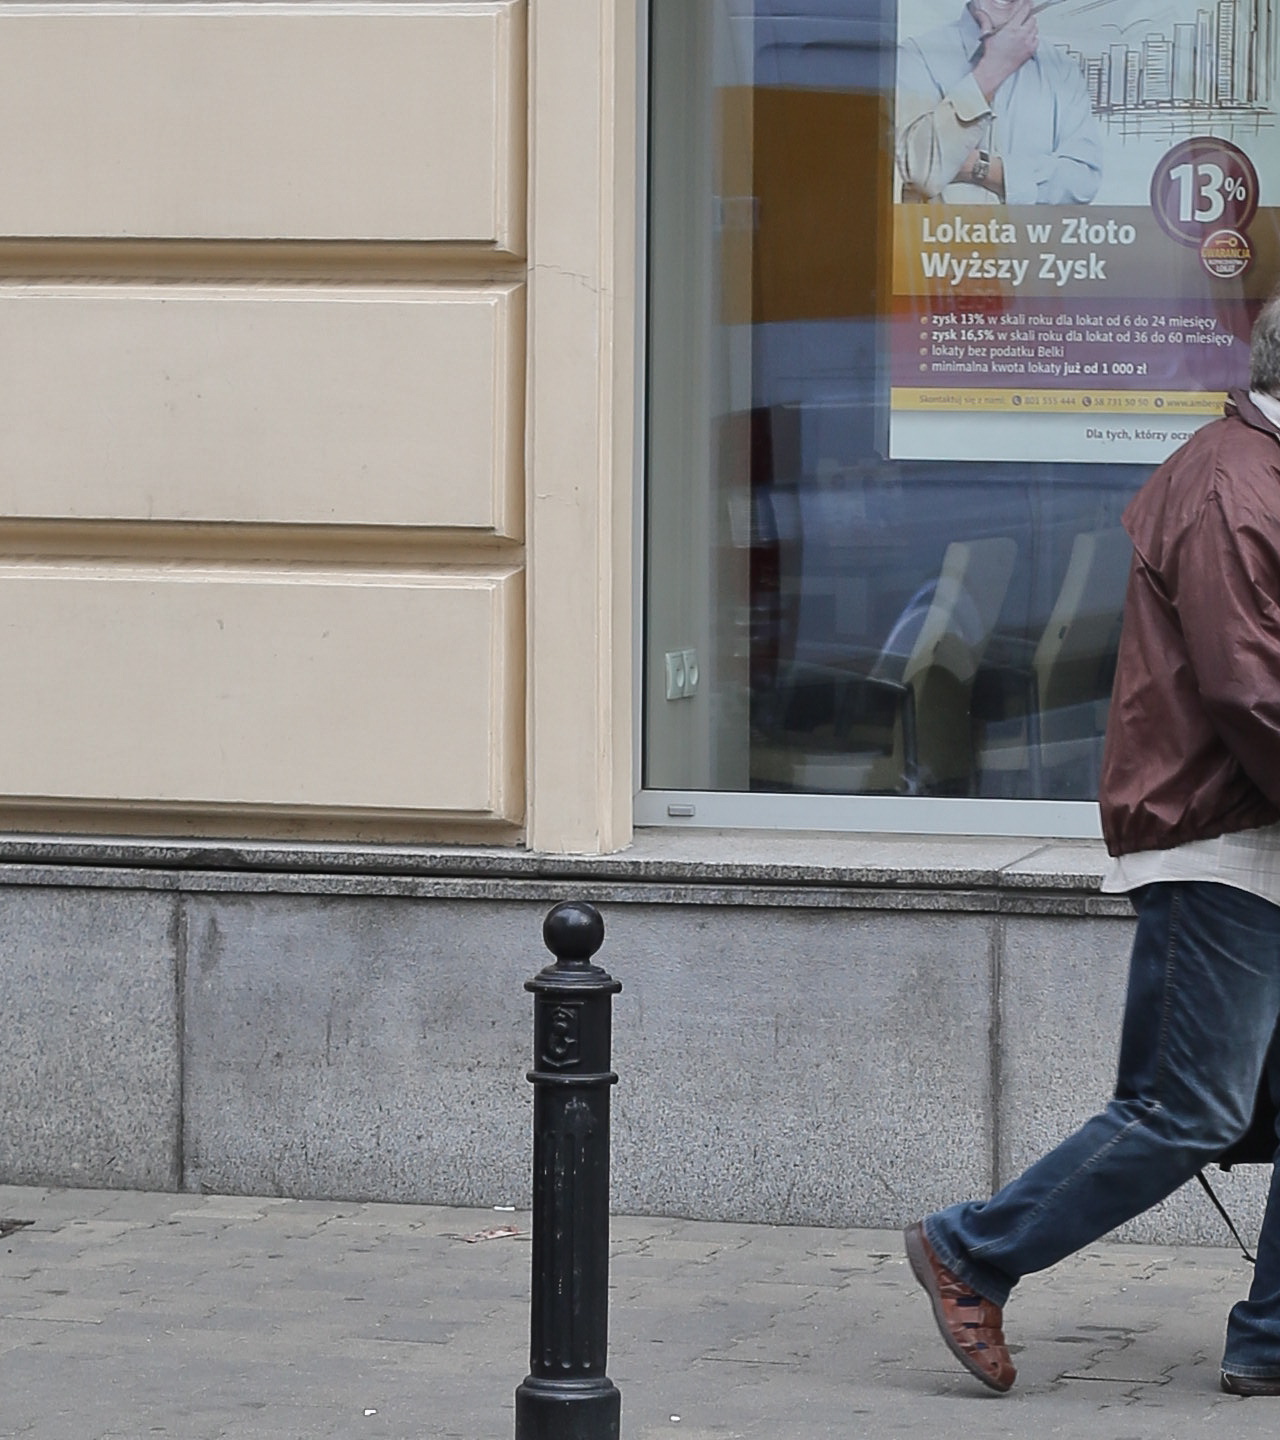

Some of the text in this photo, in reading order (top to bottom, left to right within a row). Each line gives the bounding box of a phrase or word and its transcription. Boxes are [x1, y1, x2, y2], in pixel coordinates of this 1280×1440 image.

[922, 216, 1136, 245] Lokata w Złoto
[921, 251, 1107, 287] Wyższy Zysk
[932, 313, 1217, 330] zysk 13% w skali roku dla lokat od 6 do 24 miesięcy
[932, 329, 1234, 346] zysk 16,5% w skali roku dla lokat od 36 do 60 miesięcy
[932, 345, 1065, 359] lokaty bez podatku Belki
[932, 361, 1147, 376] minimalna kwota lokaty już od 1 000 zł
[1086, 428, 1103, 439] Dla
[1106, 429, 1132, 442] tych,
[1135, 429, 1167, 442] którzy
